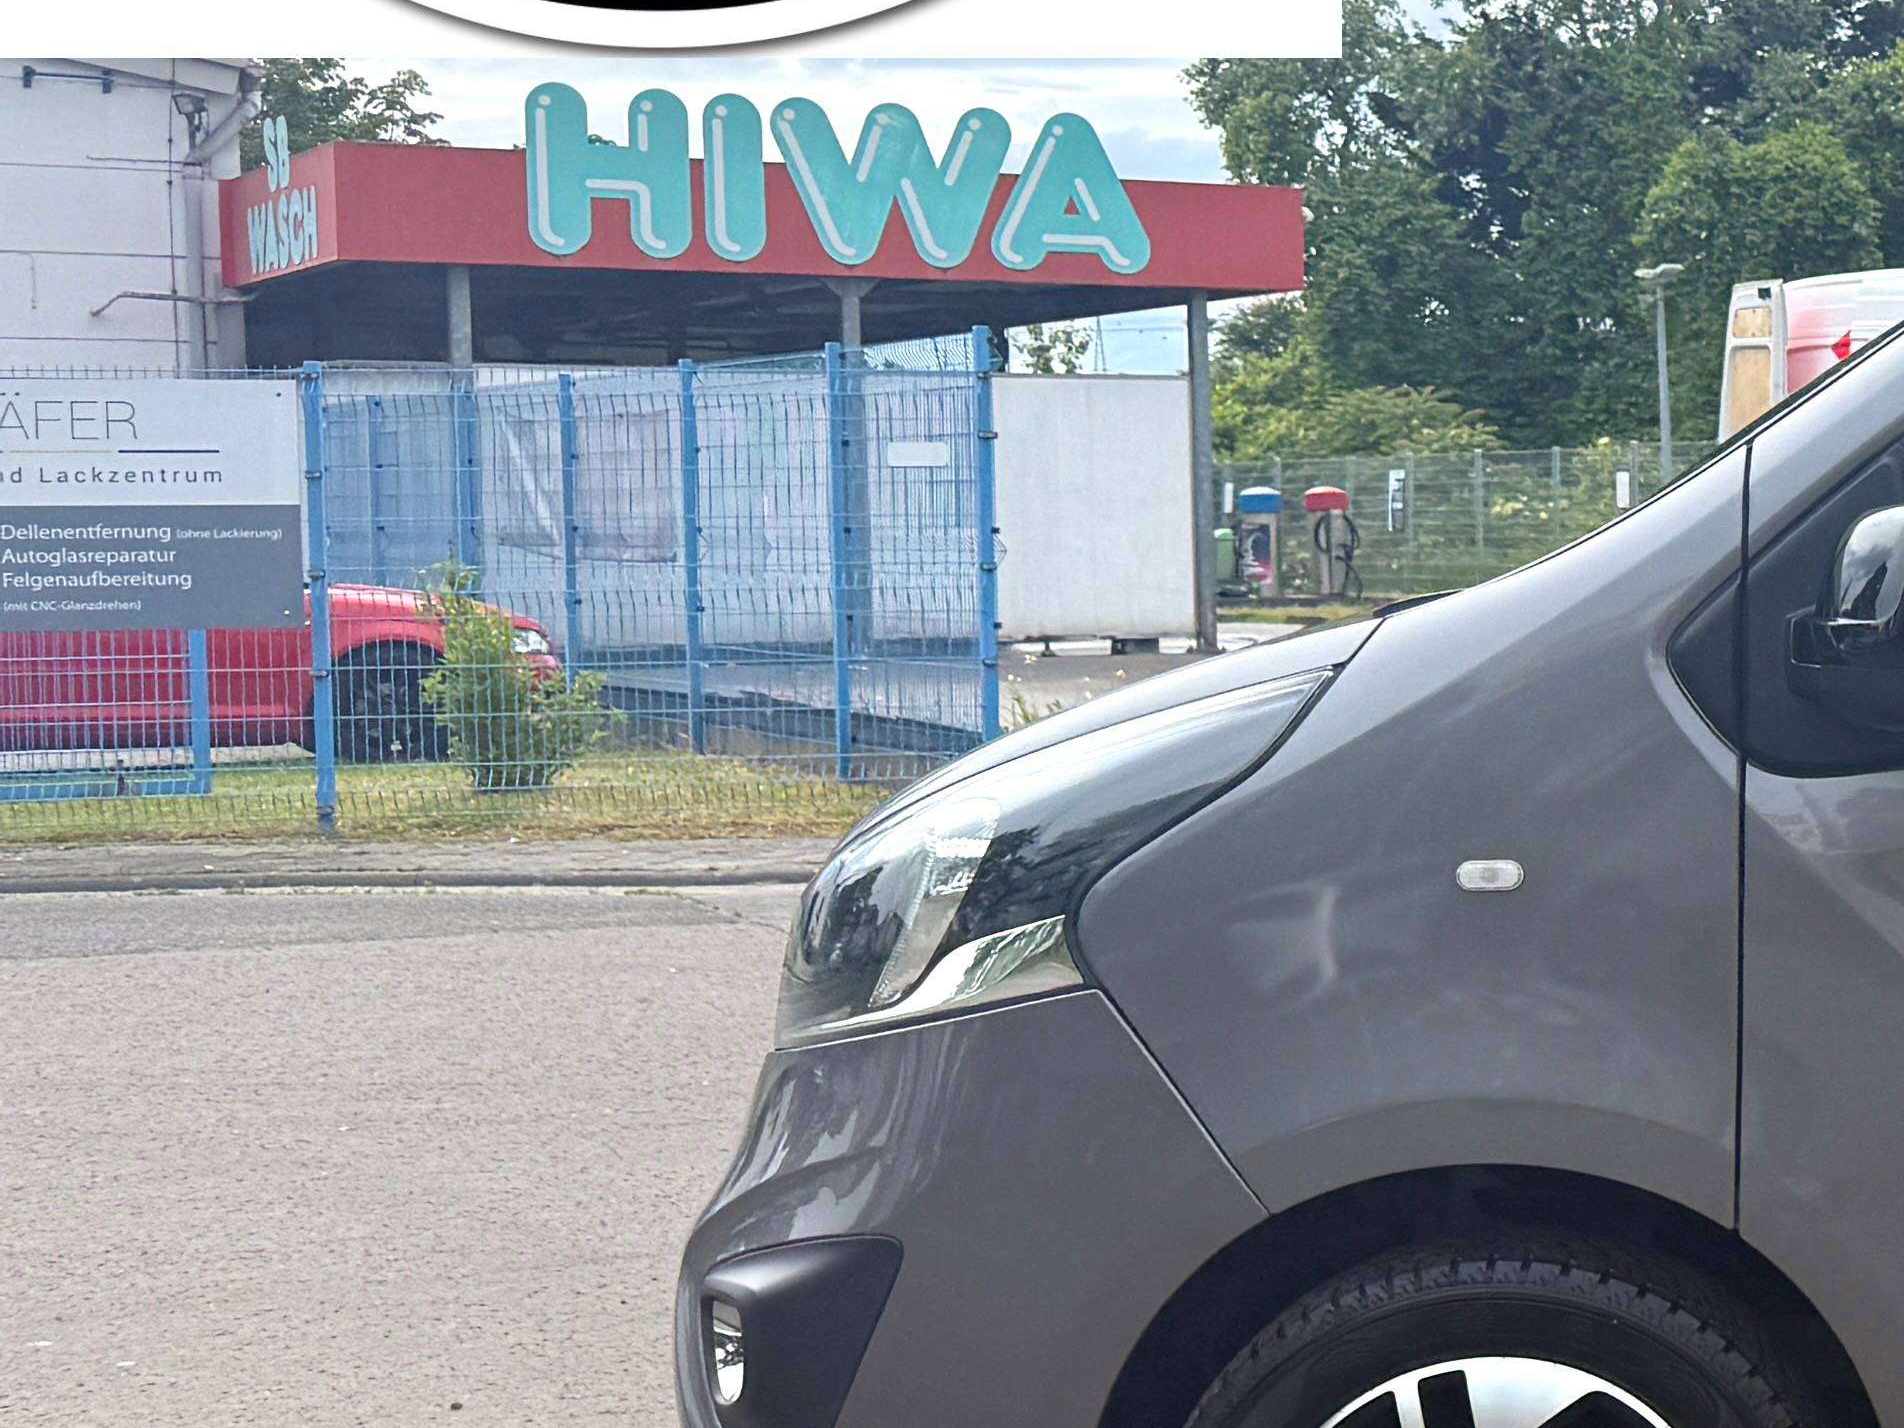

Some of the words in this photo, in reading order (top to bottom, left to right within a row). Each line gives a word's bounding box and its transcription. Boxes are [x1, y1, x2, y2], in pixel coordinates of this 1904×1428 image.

[263, 115, 290, 192] SB
[525, 82, 1151, 274] HIWA
[247, 185, 319, 274] WASCH
[39, 467, 223, 483] Lackzentrum
[0, 524, 171, 542] Dellenentfernung
[1, 548, 177, 567] Autoglasreparatur
[2, 571, 193, 590] Felgenaufbereitung
